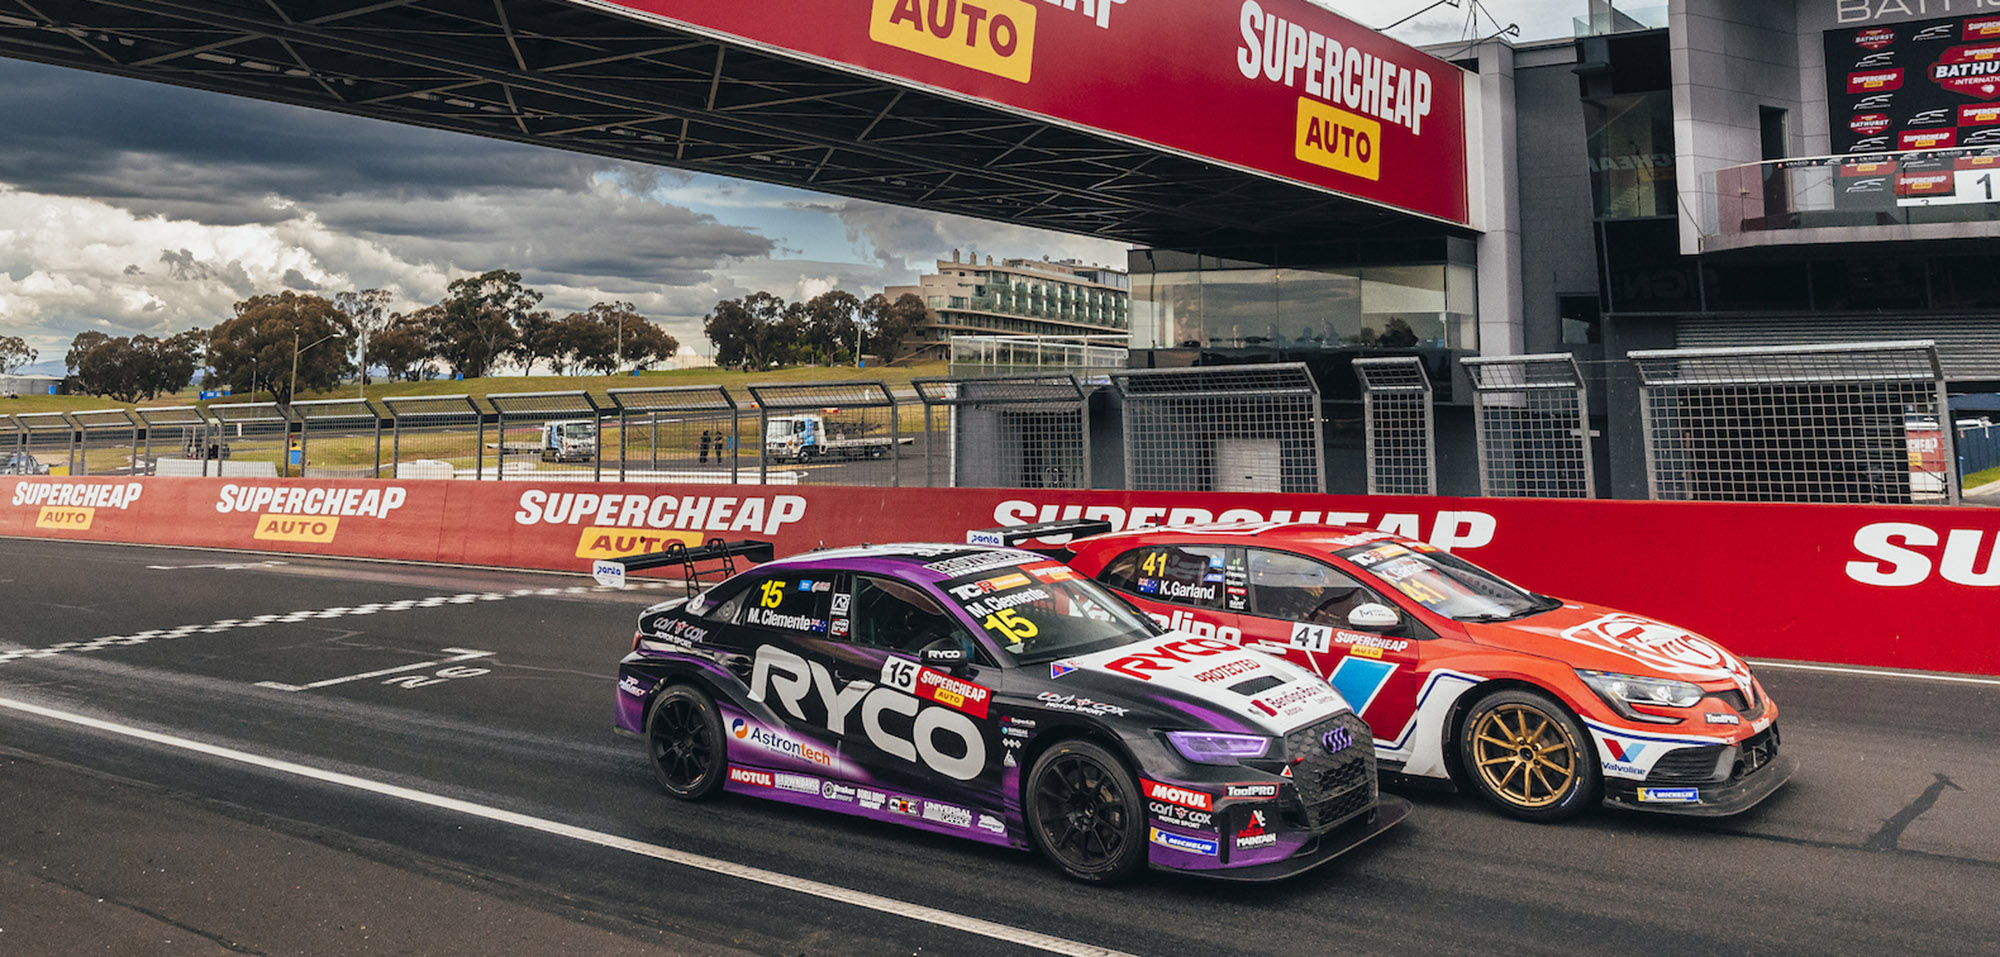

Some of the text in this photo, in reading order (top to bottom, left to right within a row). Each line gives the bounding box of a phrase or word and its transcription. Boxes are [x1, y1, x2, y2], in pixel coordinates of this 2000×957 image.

[889, 0, 1018, 58] AUTO
[1237, 0, 1432, 136] SUPERCHEAP
[1305, 115, 1371, 164] AUTO
[1976, 173, 1992, 200] 1
[12, 481, 142, 510] SUPERCHEAP
[216, 483, 407, 519] SUPERCHEAP
[43, 510, 87, 525] AUTO
[515, 489, 807, 535] SUPERCHEAP
[264, 520, 328, 536] AUTO
[1142, 552, 1167, 577] 41
[1845, 522, 2000, 587] SU
[760, 579, 786, 609] 15
[949, 579, 998, 601] TCR
[985, 588, 1049, 613] Clemente
[761, 609, 811, 631] Clemente
[983, 608, 1040, 644] 15
[683, 626, 709, 644] cox
[1295, 626, 1323, 649] 41
[1334, 631, 1408, 652] SUPERCHEAP
[927, 649, 961, 660] RYCO
[1104, 638, 1242, 681] RYCO
[1354, 646, 1379, 655] AUTO
[889, 661, 916, 688] 15
[1193, 658, 1260, 684] PROTECTED
[920, 670, 987, 703] SUPERCHEAP
[937, 690, 961, 704] AUTO
[747, 644, 986, 781] RYCO
[1037, 691, 1130, 717] carl cox
[1045, 701, 1106, 717] MOTOR SPORT
[750, 727, 831, 767] Astrontech
[731, 769, 772, 786] MOTUL
[1602, 760, 1646, 776] Valvoline
[1151, 785, 1207, 808] MOTUL
[1227, 785, 1276, 797] ToolPRO
[924, 801, 971, 818] UNIVERSAL
[1149, 801, 1213, 826] carl cox
[1158, 815, 1201, 830] MOTOR SPORT
[1168, 837, 1213, 852] MICHELIN
[1236, 833, 1277, 847] MAINTAIN
